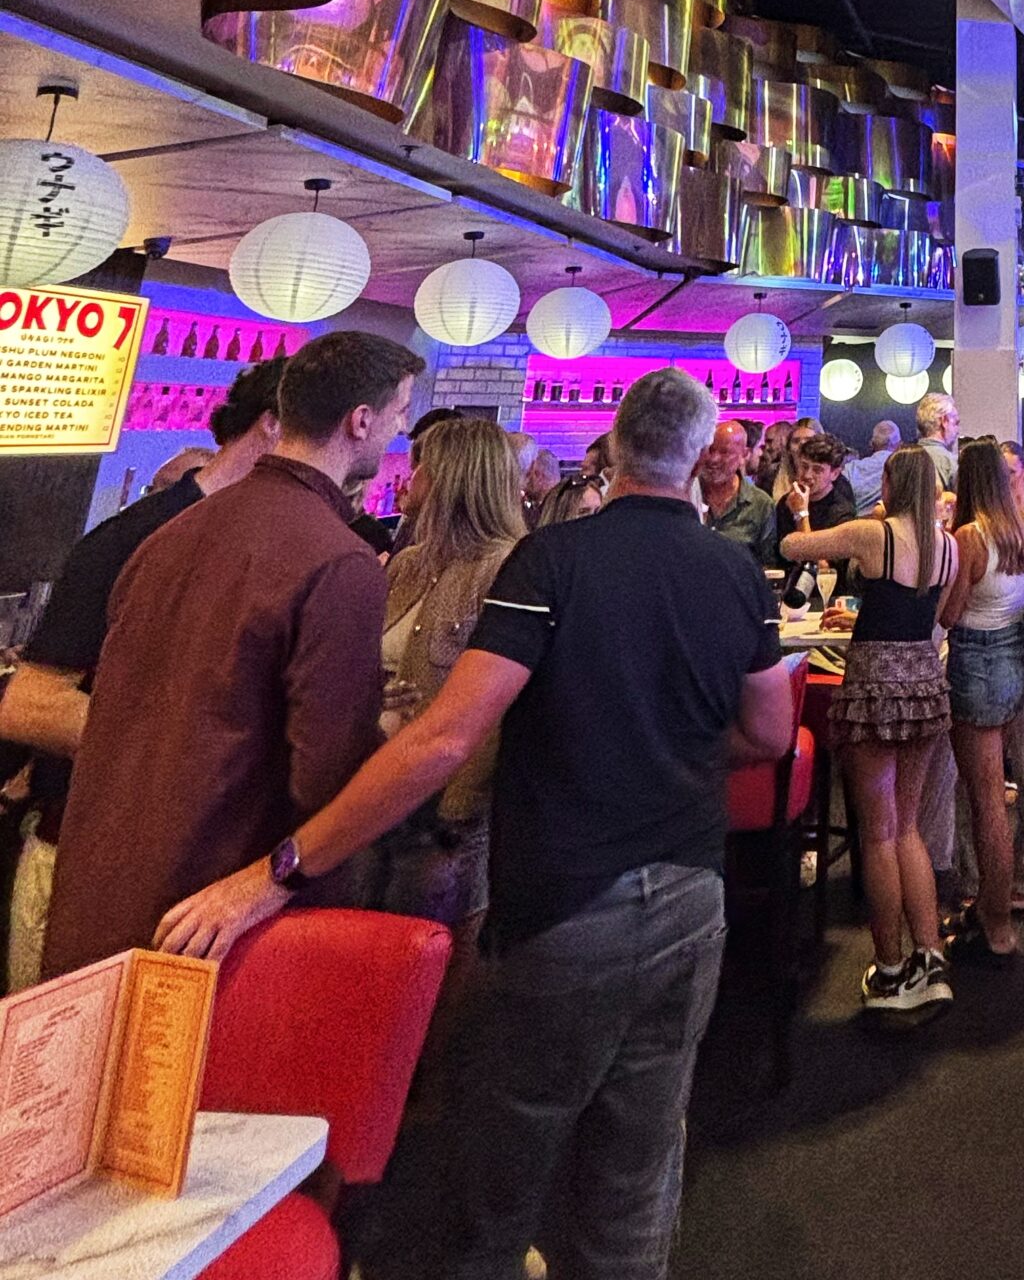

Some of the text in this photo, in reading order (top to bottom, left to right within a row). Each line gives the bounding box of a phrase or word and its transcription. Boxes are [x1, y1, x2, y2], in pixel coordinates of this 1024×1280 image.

[36, 152, 75, 237] ウナギ
[112, 306, 137, 351] 7
[20, 333, 54, 343] UNAGI
[0, 345, 106, 361] SHU PLUM NEGRONI
[6, 359, 52, 369] GARDEN
[56, 363, 98, 372] MARTINI
[1, 372, 42, 381] MANGO
[46, 375, 105, 384] MARGARITA
[12, 385, 72, 395] SPARKLING
[75, 388, 107, 396] ELIXIR
[4, 398, 94, 407] SUNSET COLADA
[24, 411, 49, 419] ICED
[54, 411, 73, 419] TEA
[45, 424, 89, 432] MARTINI
